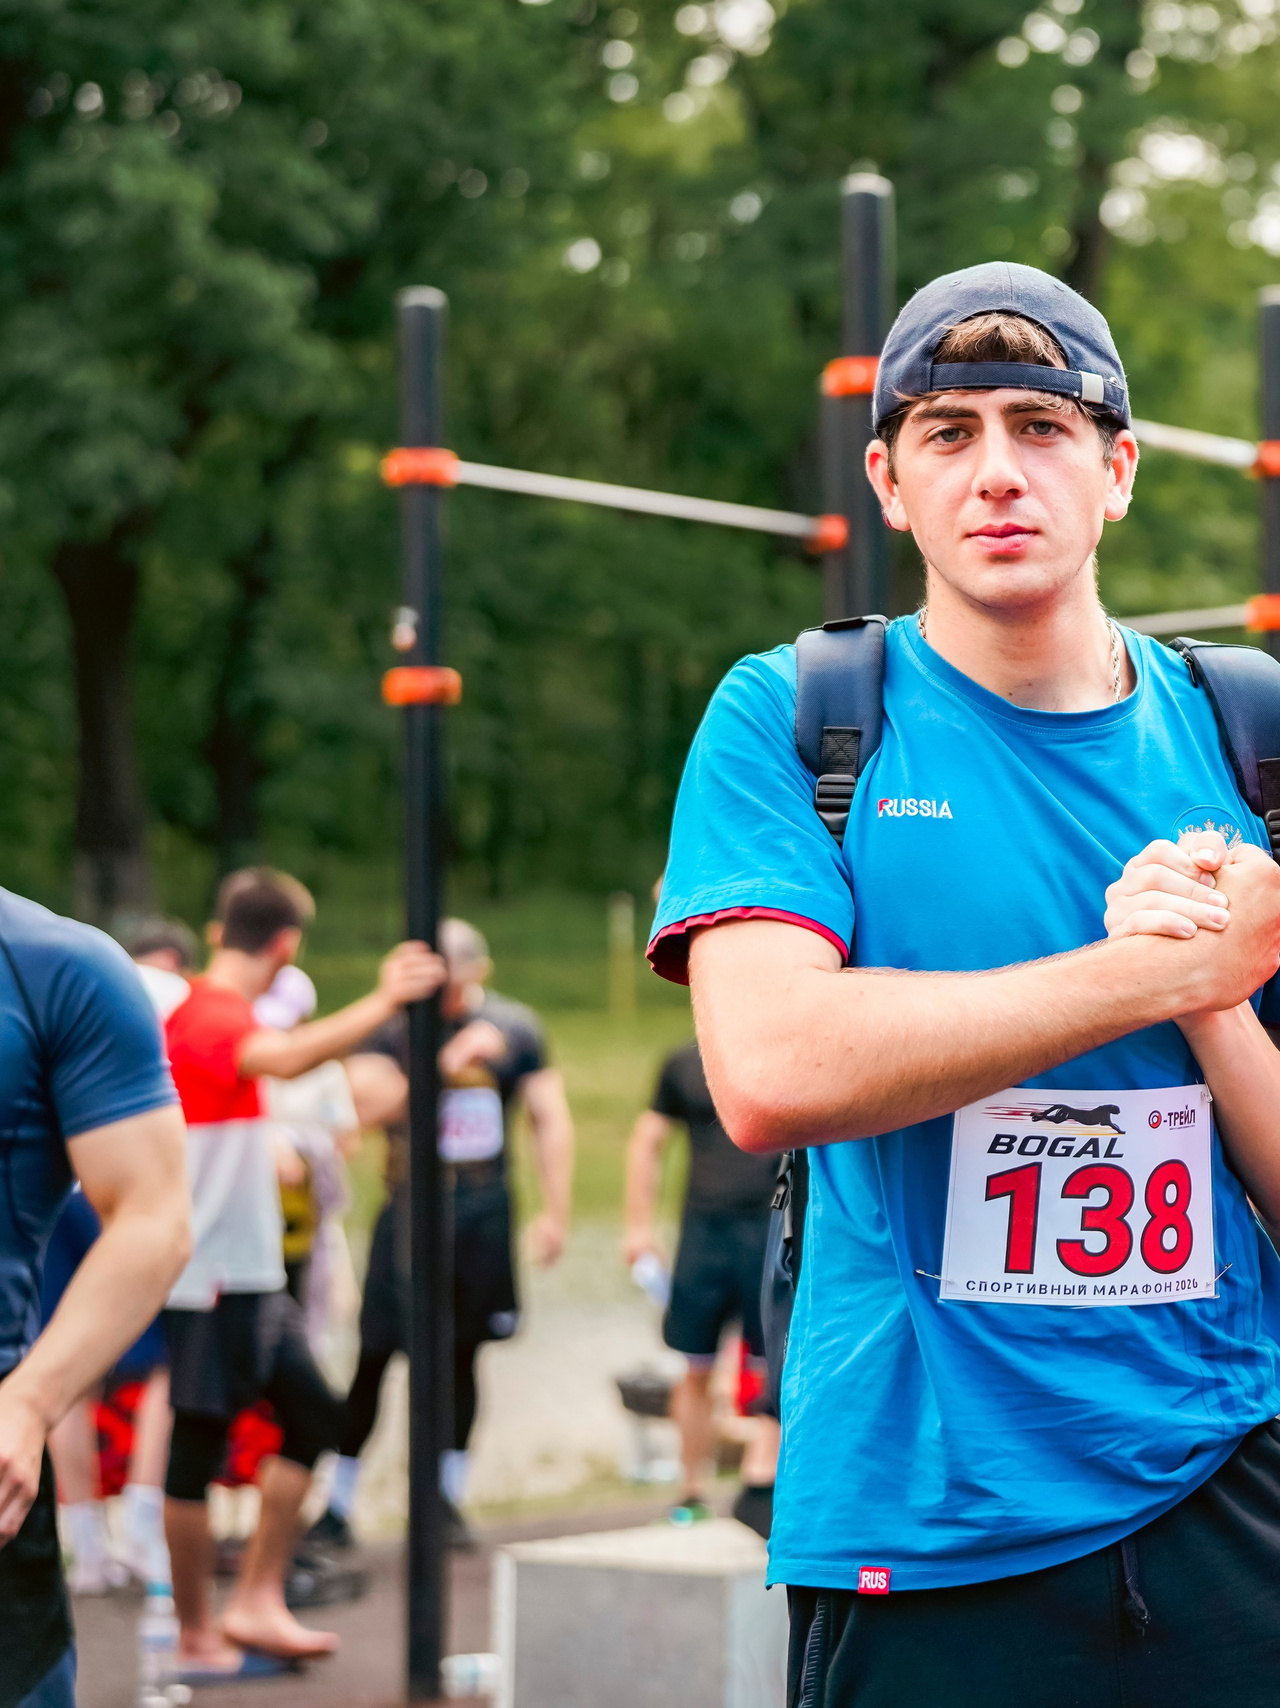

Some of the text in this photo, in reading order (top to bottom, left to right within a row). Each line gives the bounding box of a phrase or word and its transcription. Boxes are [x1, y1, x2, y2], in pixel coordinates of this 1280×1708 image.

[878, 798, 953, 819] RUSSIA
[986, 1133, 1125, 1159] BOGAL
[985, 1158, 1193, 1278] 138
[966, 1278, 1199, 1296] СПОРТИВНЫЙ МАРАФОН 2026
[860, 1571, 887, 1589] RUS
